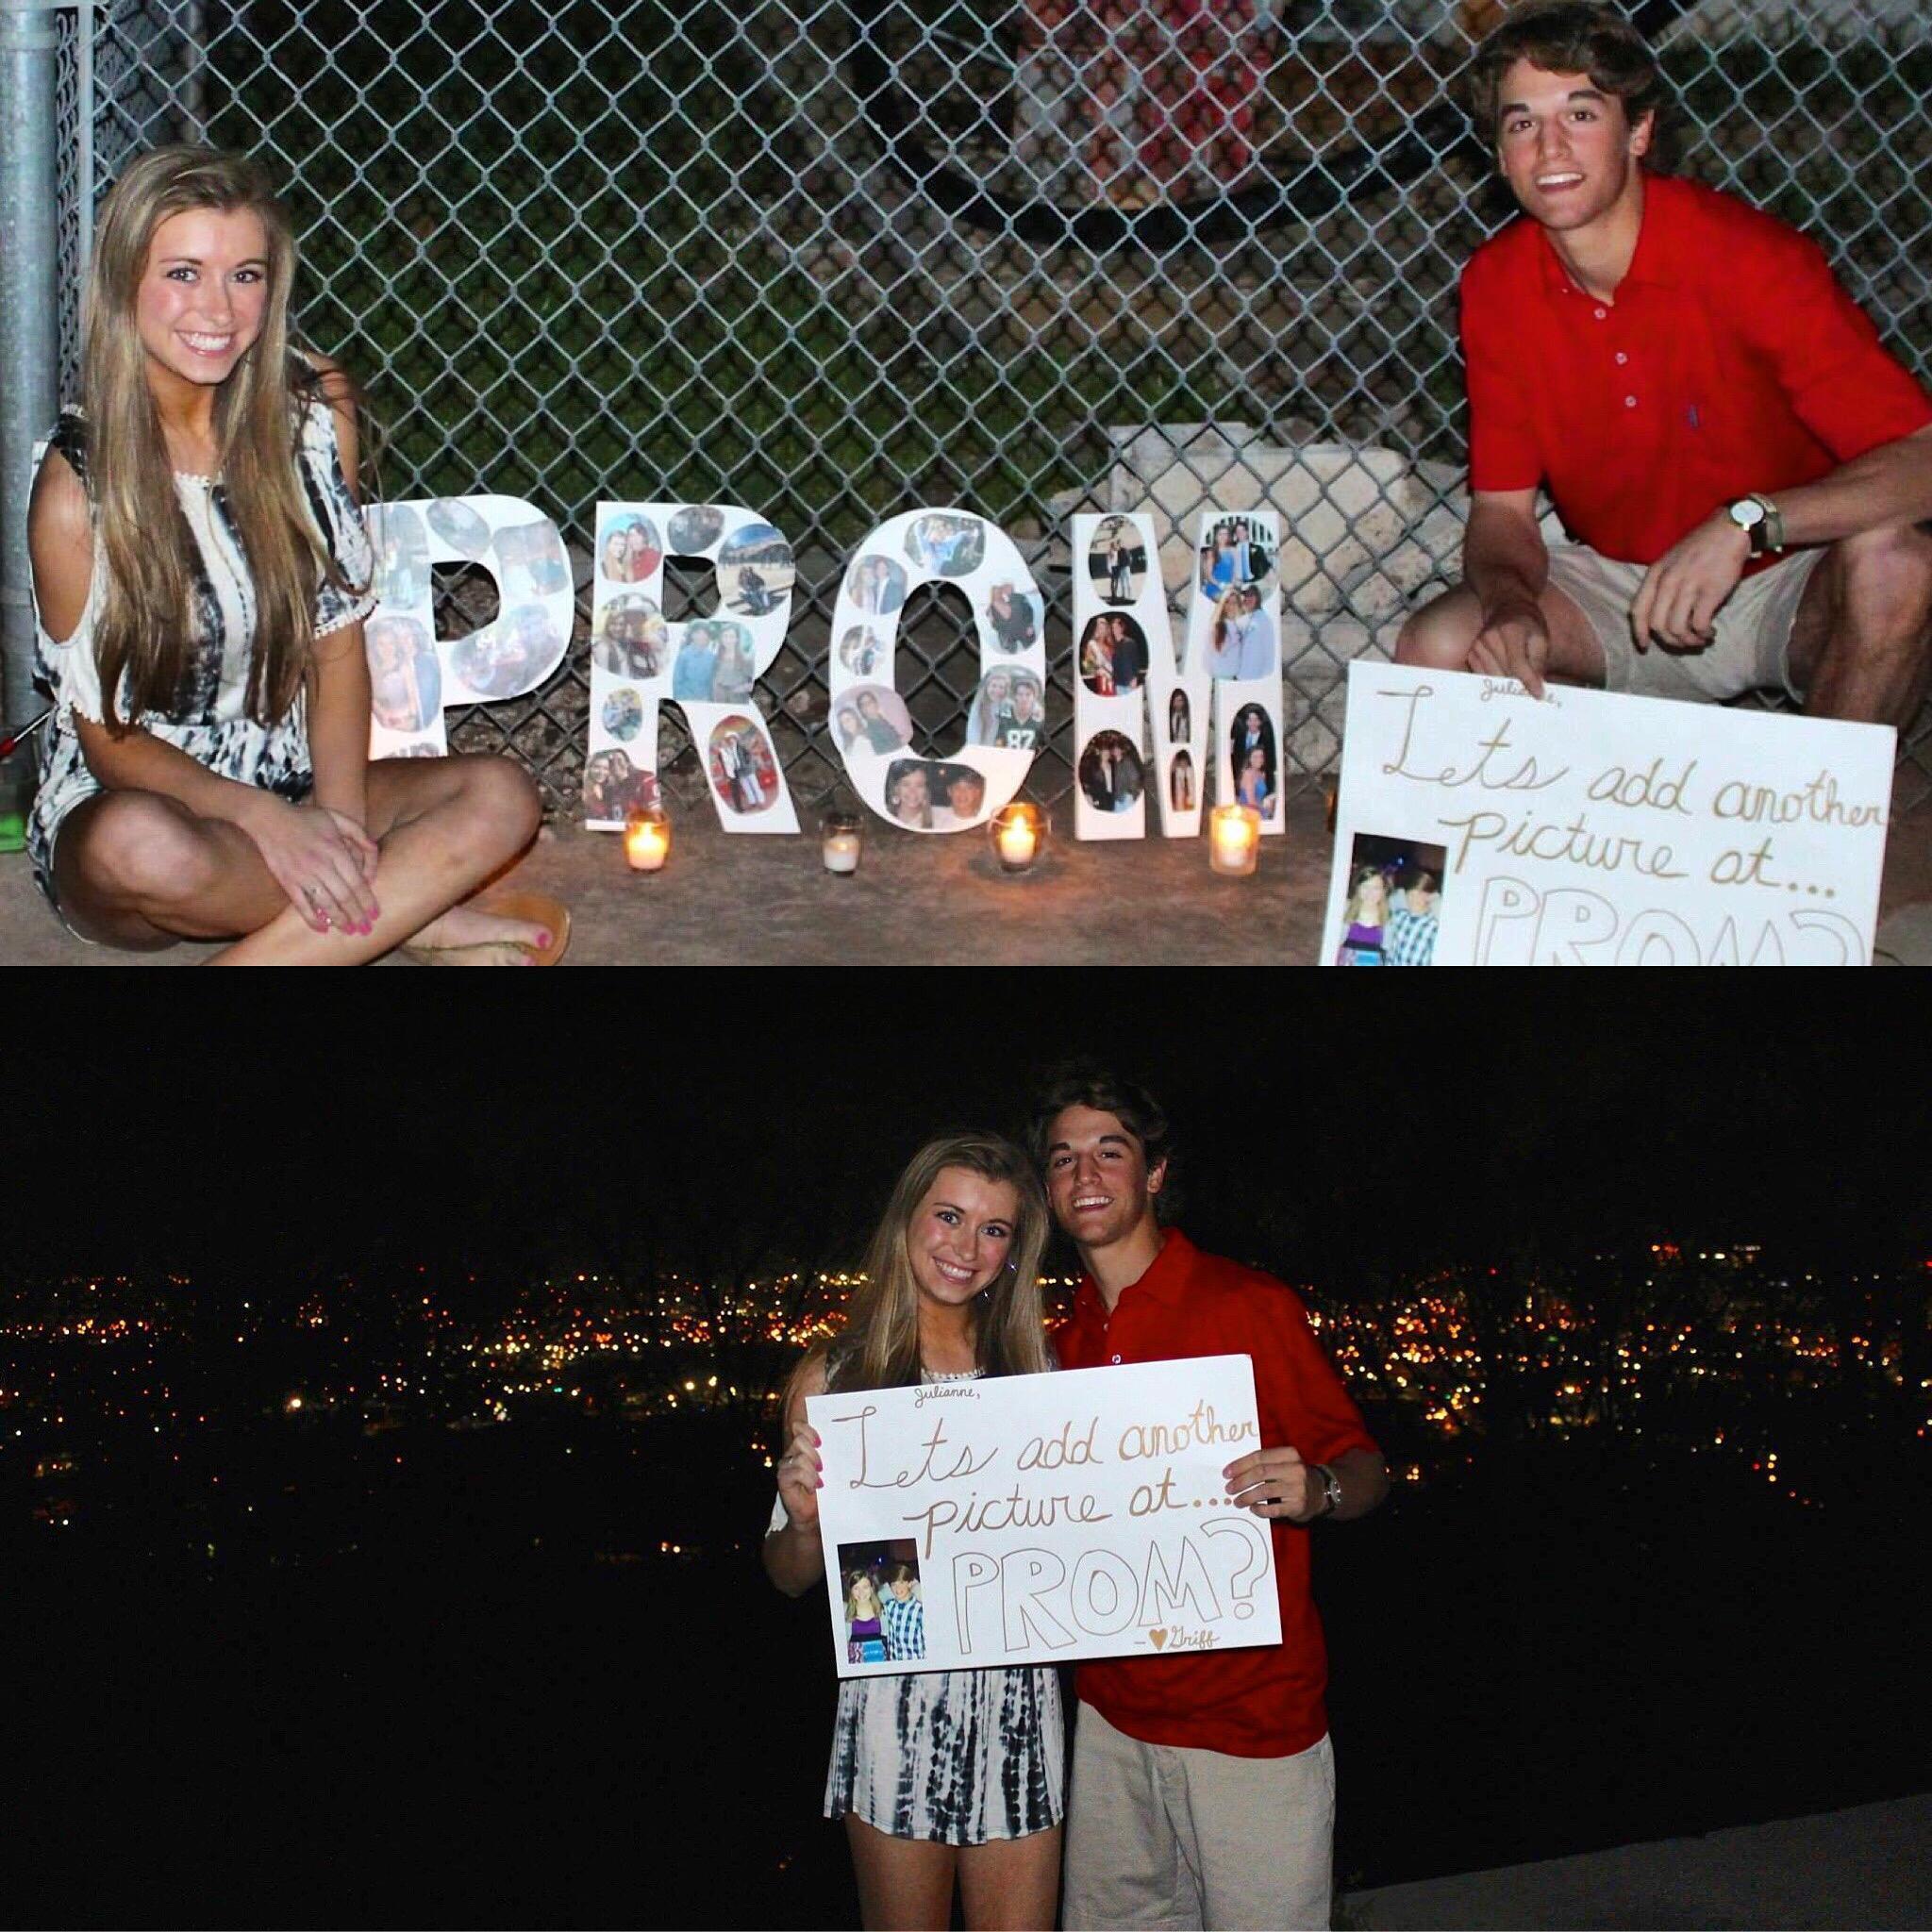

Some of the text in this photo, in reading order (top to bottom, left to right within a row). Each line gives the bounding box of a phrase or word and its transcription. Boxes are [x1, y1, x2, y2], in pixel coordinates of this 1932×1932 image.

[362, 493, 1287, 842] PROM
[1376, 684, 1890, 828] Lets add another
[832, 1399, 1259, 1489] Lets add another
[913, 1385, 981, 1409] Julianne,
[903, 1483, 1113, 1560] picture
[952, 1517, 1270, 1655] PROM?
